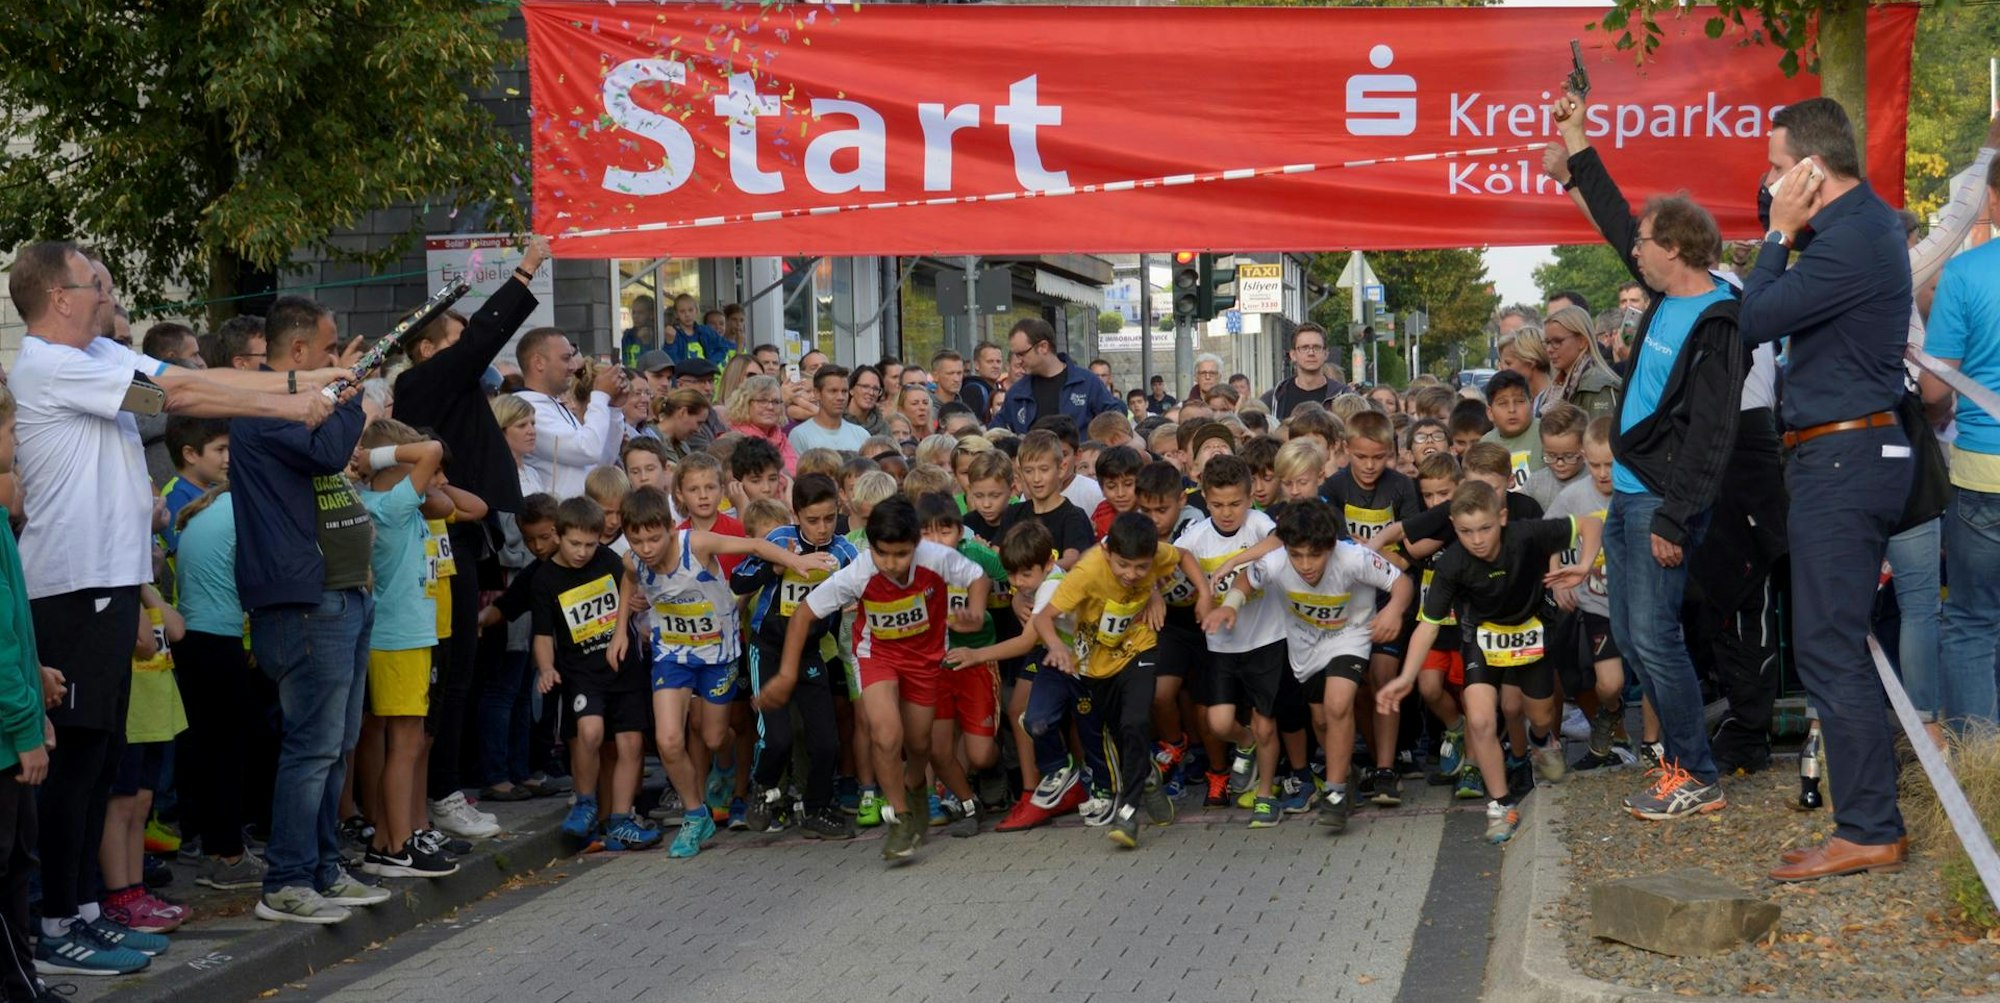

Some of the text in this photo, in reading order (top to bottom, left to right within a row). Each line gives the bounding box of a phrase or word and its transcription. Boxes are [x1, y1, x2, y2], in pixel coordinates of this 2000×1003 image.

[601, 58, 1070, 196] Start
[1448, 160, 1564, 195] Köln
[1243, 267, 1278, 277] TAXI
[318, 491, 352, 510] DARE
[786, 584, 821, 602] 12
[569, 592, 617, 625] 1279
[869, 607, 924, 628] 1288
[1292, 601, 1345, 619] 1787
[663, 615, 713, 633] 1813
[1483, 629, 1538, 649] 1083
